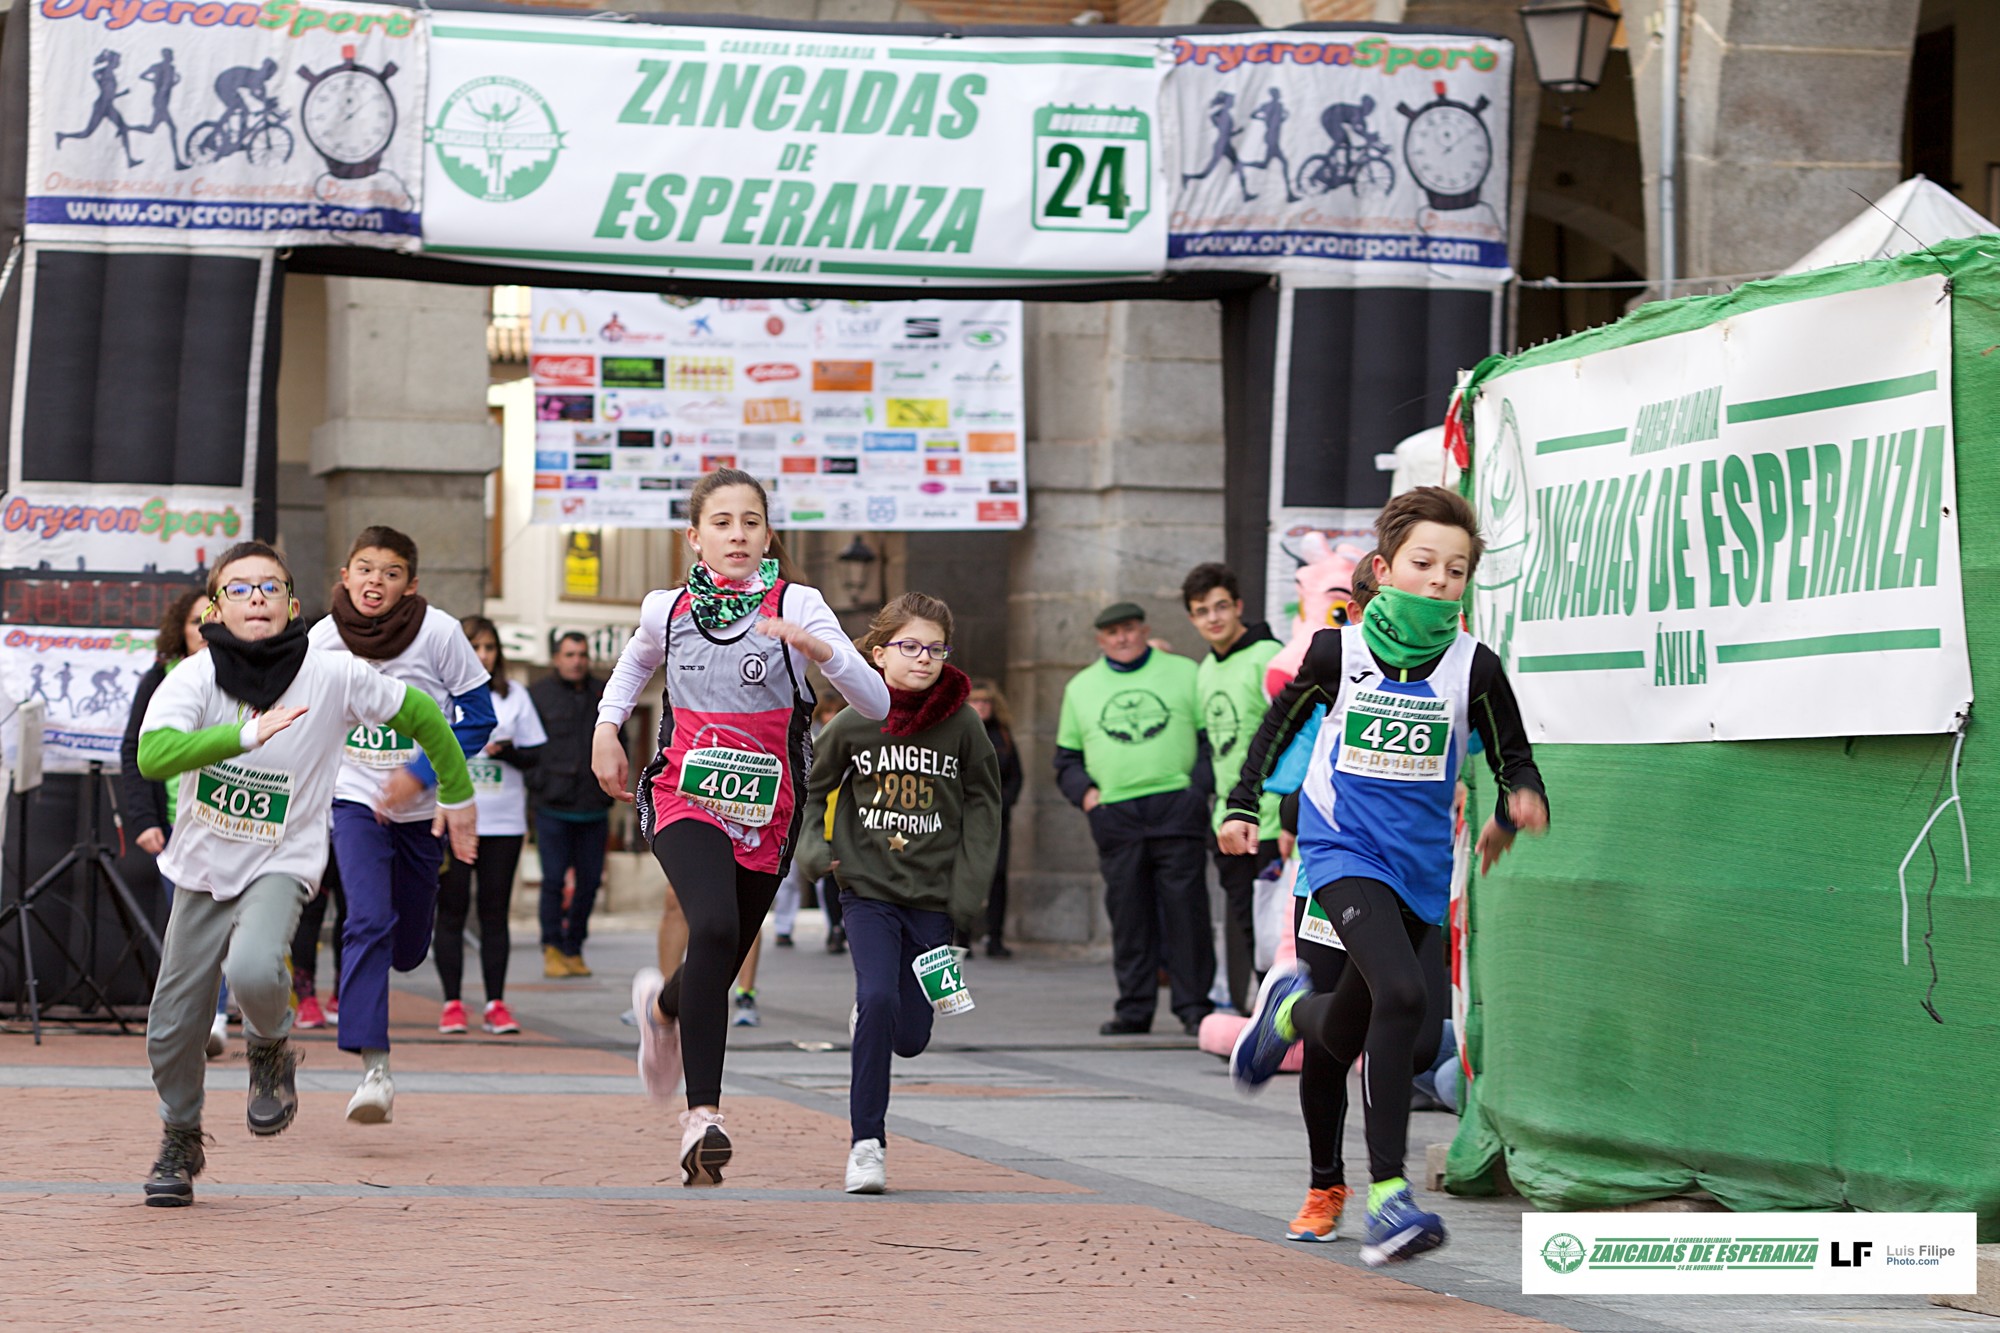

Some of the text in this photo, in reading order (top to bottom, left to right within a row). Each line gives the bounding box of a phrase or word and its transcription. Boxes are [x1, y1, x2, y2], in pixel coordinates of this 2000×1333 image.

[720, 40, 875, 60] CARRERA SOLIDARIA
[617, 58, 988, 140] ZANCADAS
[777, 143, 818, 171] DE
[1044, 142, 1131, 219] 24
[66, 200, 384, 230] www.orycronsport.com
[592, 172, 985, 254] ESPERANZA
[1185, 234, 1481, 262] www.orycronsport.com
[761, 253, 813, 274] ÁVILA
[3, 496, 243, 543] OrycronSport
[1521, 426, 1945, 621] ZANCADAS DE ESPERANZA
[4, 629, 156, 654] OrycronSpo
[1655, 622, 1707, 687] ÁVILA
[1354, 691, 1396, 707] CARRERA
[351, 725, 397, 749] 401
[1360, 718, 1432, 754] 426
[734, 753, 777, 767] SOLIDARIA
[877, 744, 959, 779] ANGELES
[243, 767, 290, 784] SOLIDARIA
[699, 770, 760, 802] 404
[210, 783, 271, 819] 403
[858, 807, 943, 834] CALIFORNIA
